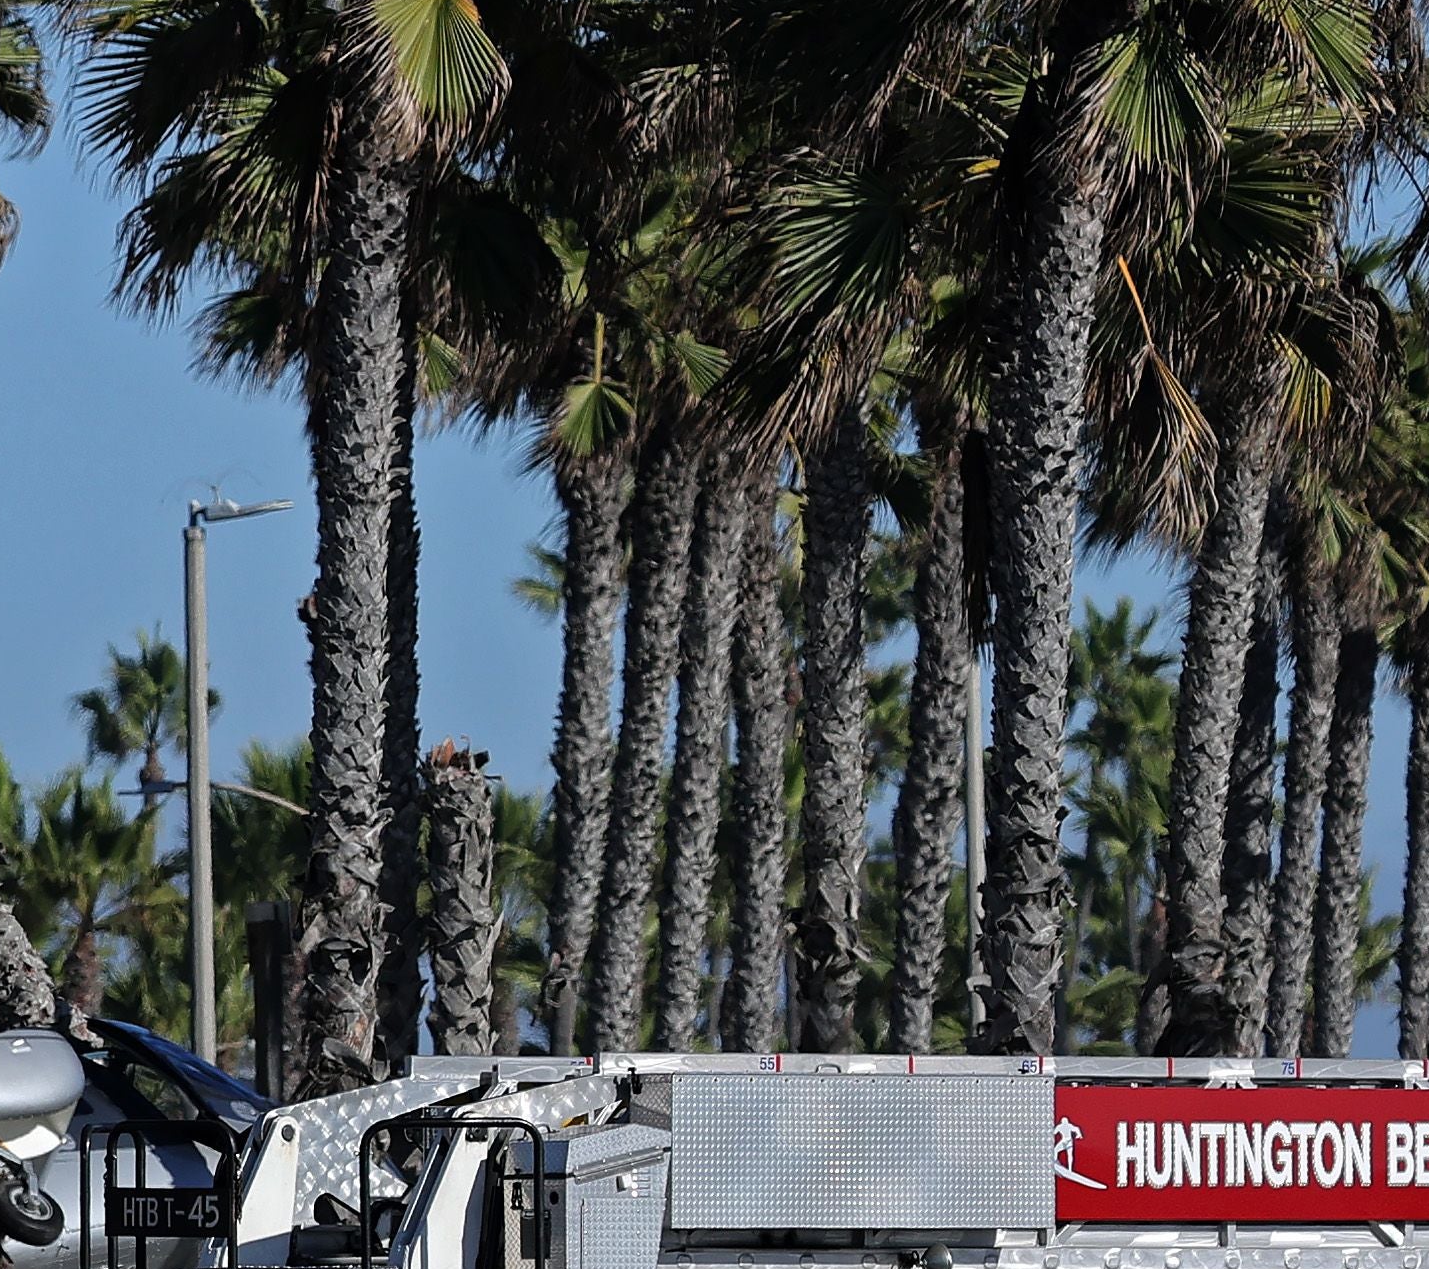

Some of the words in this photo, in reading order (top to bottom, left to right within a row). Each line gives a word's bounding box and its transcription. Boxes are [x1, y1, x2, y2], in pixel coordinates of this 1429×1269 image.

[759, 1056, 775, 1071] 55
[1282, 1060, 1296, 1076] 75
[1116, 1121, 1372, 1189] HUNTINGTON
[123, 1196, 159, 1228] HTB
[164, 1194, 221, 1229] T-45
